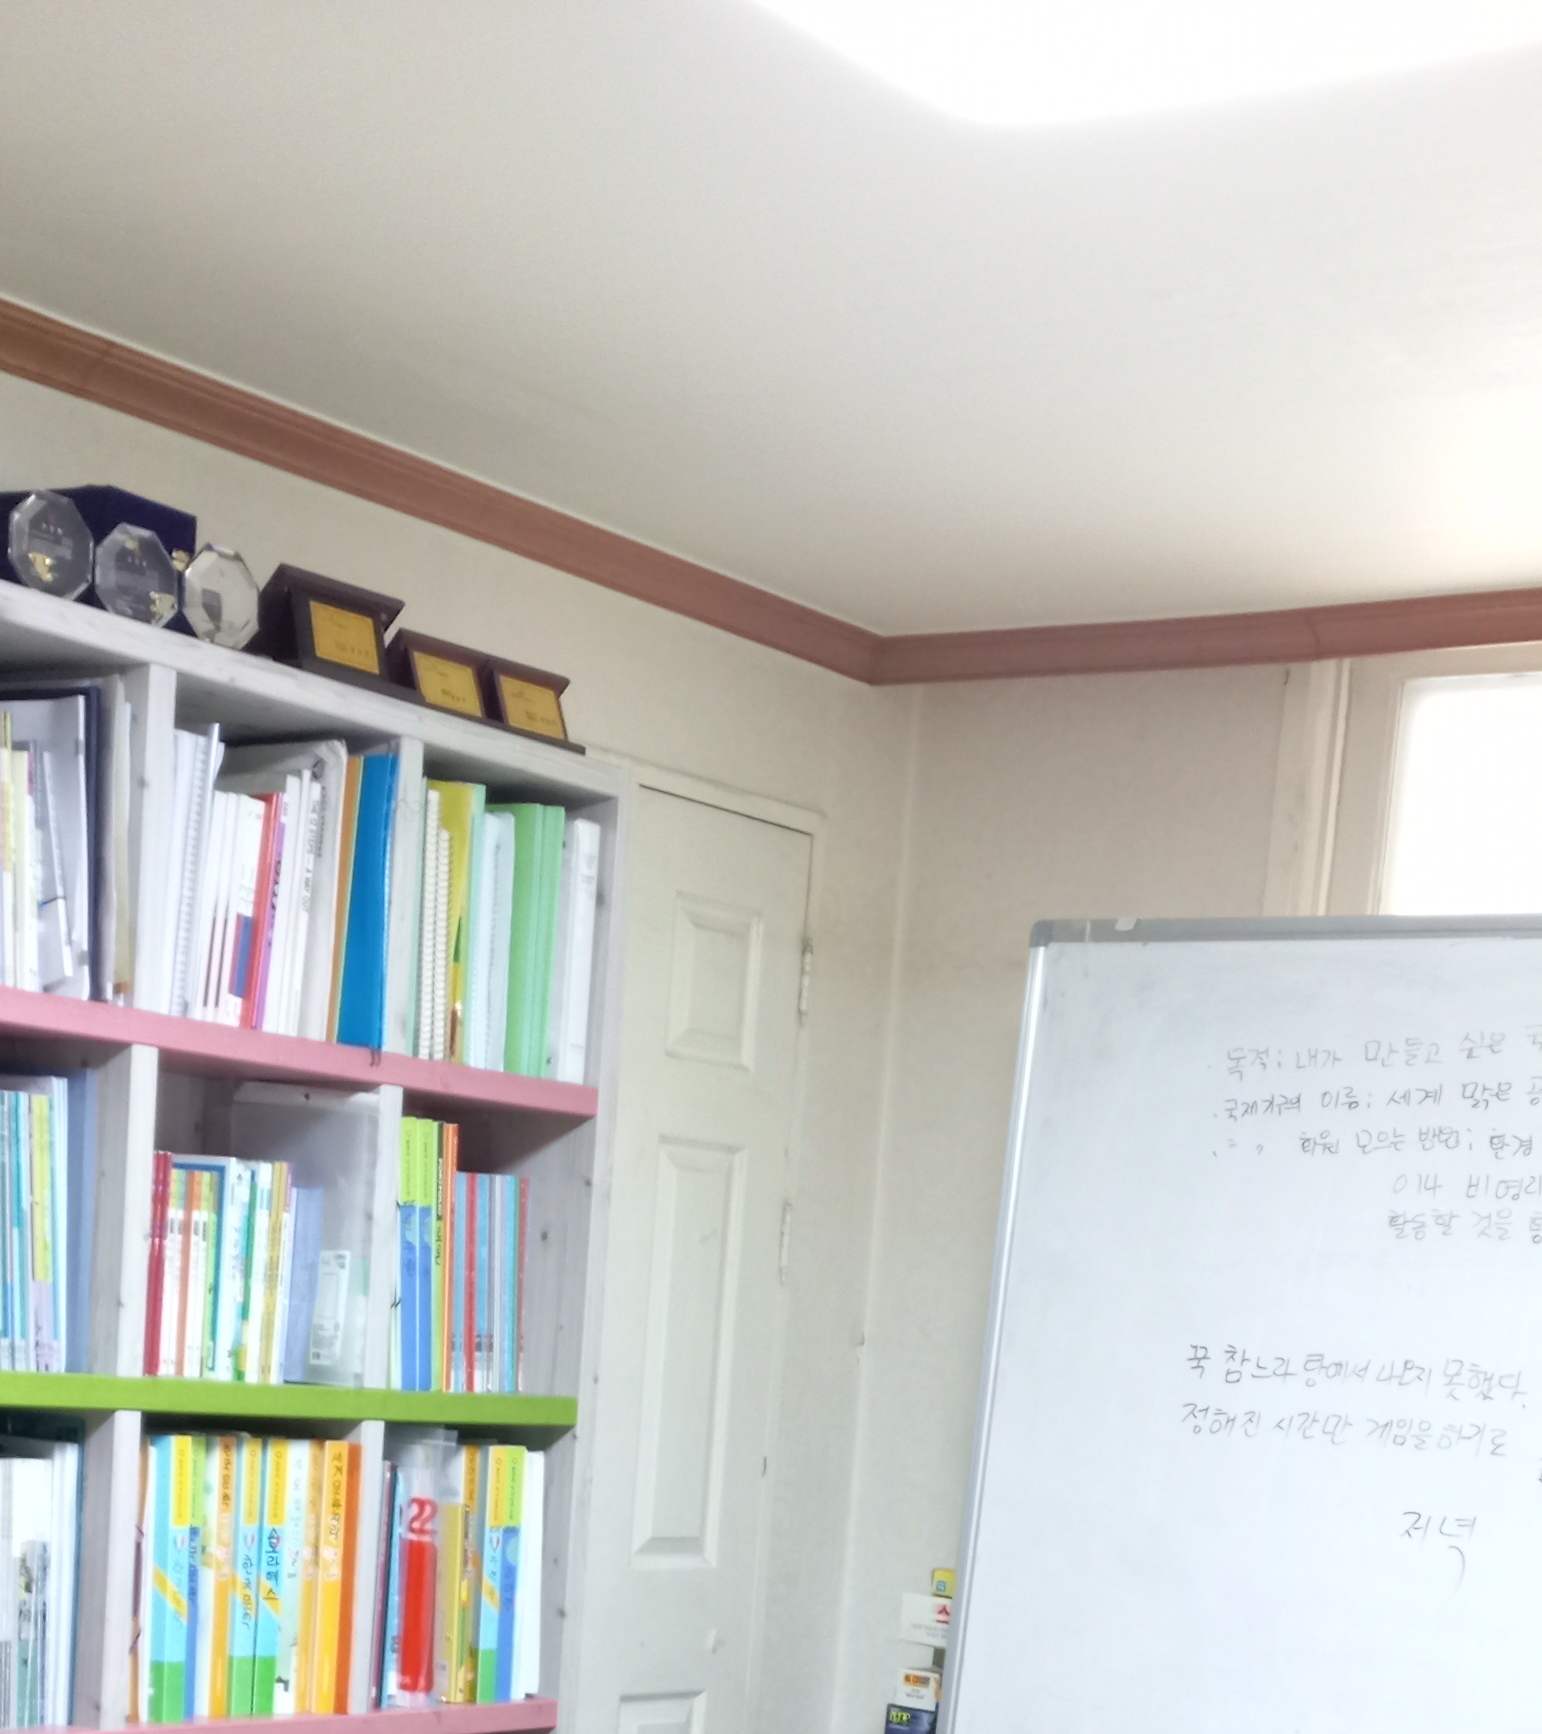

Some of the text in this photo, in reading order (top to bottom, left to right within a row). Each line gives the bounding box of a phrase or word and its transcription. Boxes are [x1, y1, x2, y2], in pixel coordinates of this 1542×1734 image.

[1295, 1047, 1342, 1069] 내가
[1365, 1037, 1444, 1067] 만들고
[1460, 1032, 1507, 1058] 싶은
[1387, 1083, 1444, 1108] 세계
[1462, 1080, 1513, 1110] 맑은
[1354, 1129, 1406, 1155] 모으는
[1489, 1130, 1534, 1160] 환경
[1473, 1207, 1514, 1242] 것을
[1400, 1511, 1477, 1589] 저녁
